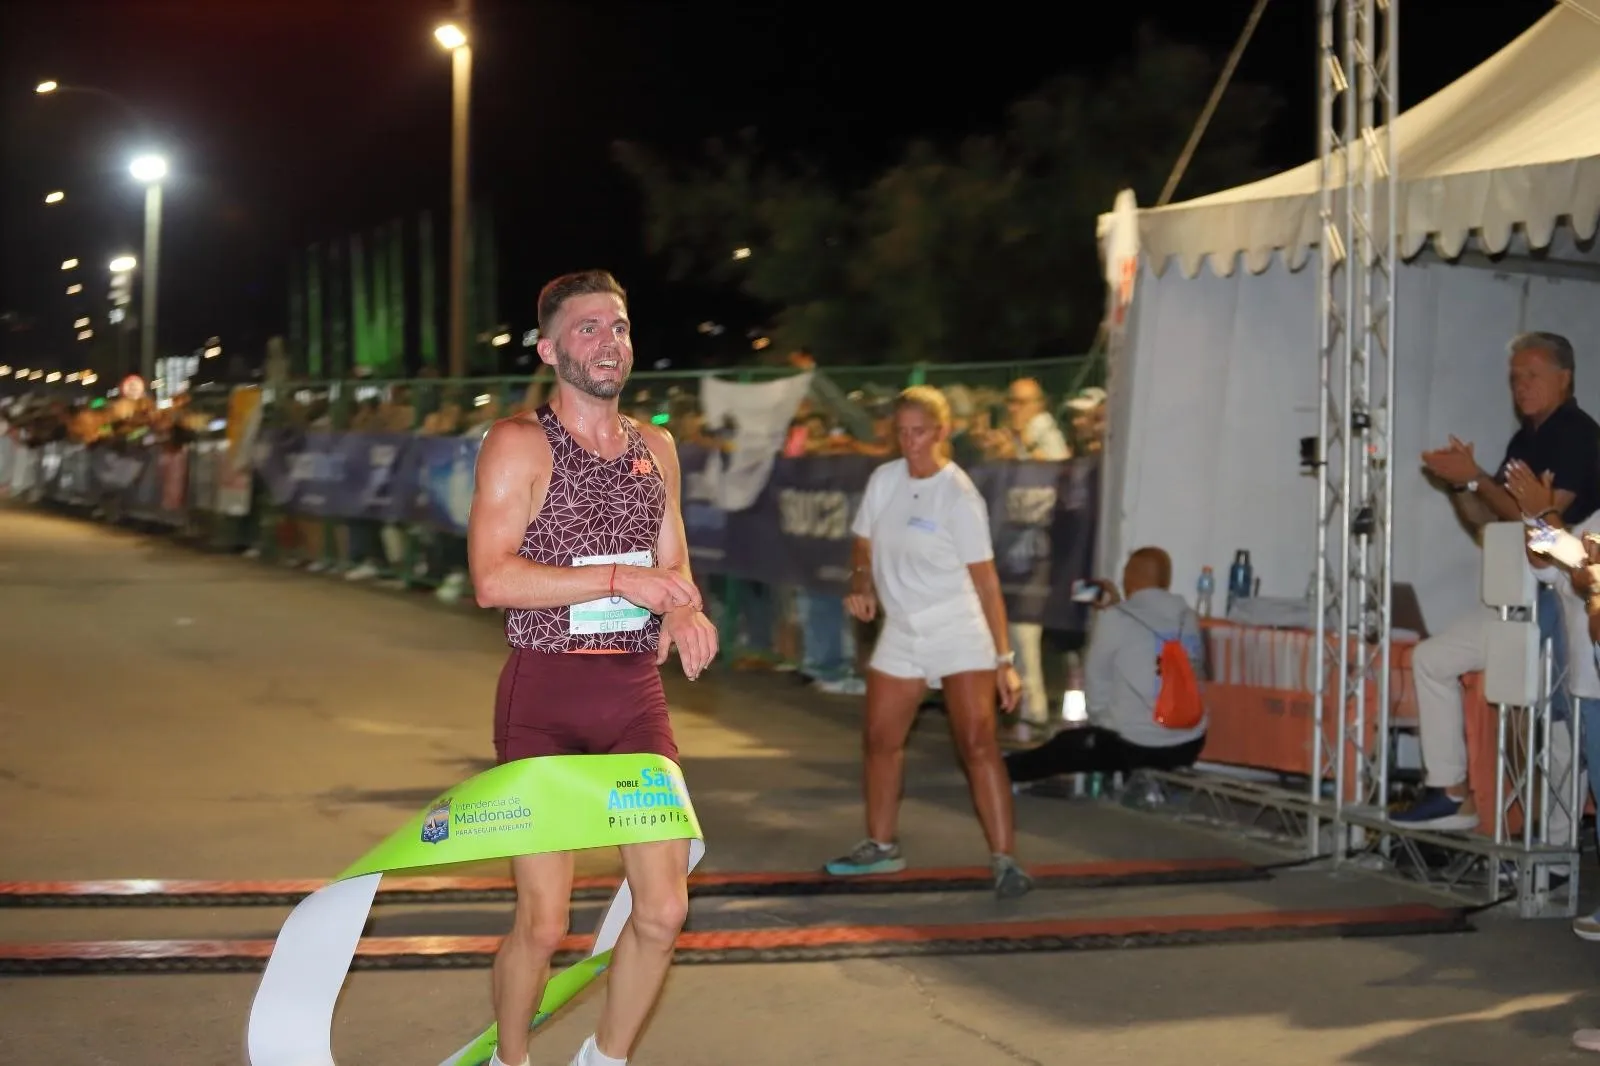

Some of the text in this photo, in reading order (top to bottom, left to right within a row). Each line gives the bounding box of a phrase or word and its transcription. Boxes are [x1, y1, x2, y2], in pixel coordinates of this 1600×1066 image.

[599, 620, 627, 631] ELITE
[616, 780, 639, 788] DOBLE
[455, 799, 506, 811] Intendencia
[455, 805, 532, 824] Maldonado
[608, 811, 689, 828] Piriápolis
[455, 828, 473, 836] PARA
[474, 826, 497, 835] SEGUIR
